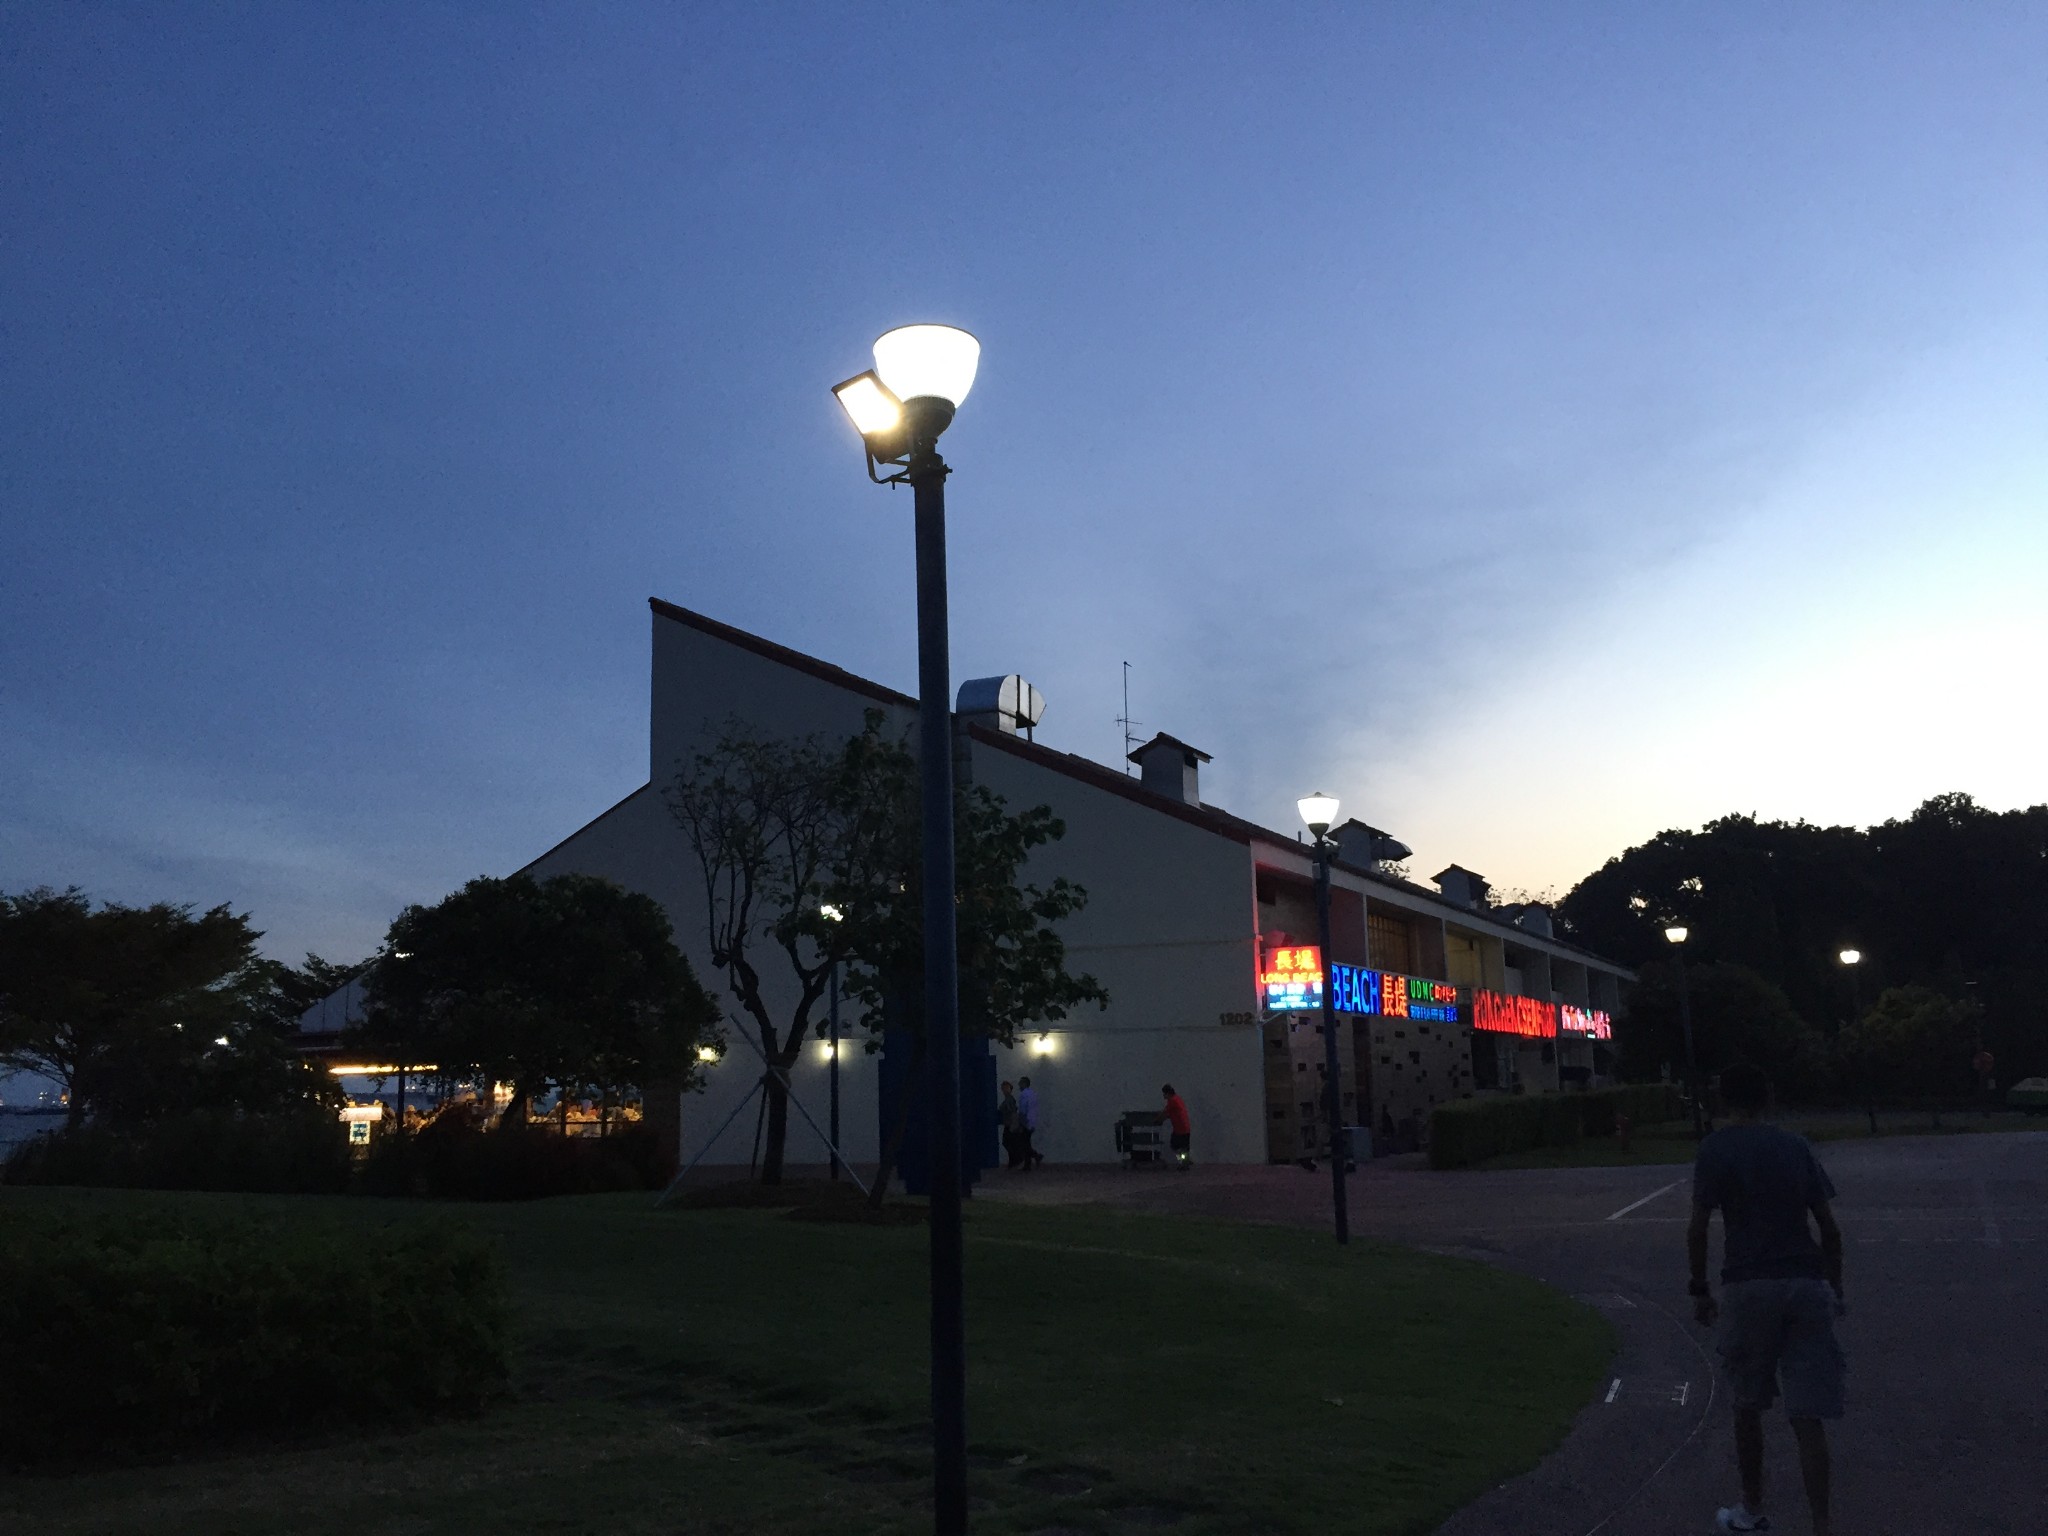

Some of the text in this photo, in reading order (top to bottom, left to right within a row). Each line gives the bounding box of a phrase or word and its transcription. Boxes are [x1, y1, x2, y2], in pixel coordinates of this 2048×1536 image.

[1260, 971, 1323, 984] LONG BEAC
[1331, 964, 1380, 1015] BEACH
[1410, 979, 1434, 1002] UDMC
[1220, 1012, 1255, 1026] 1202
